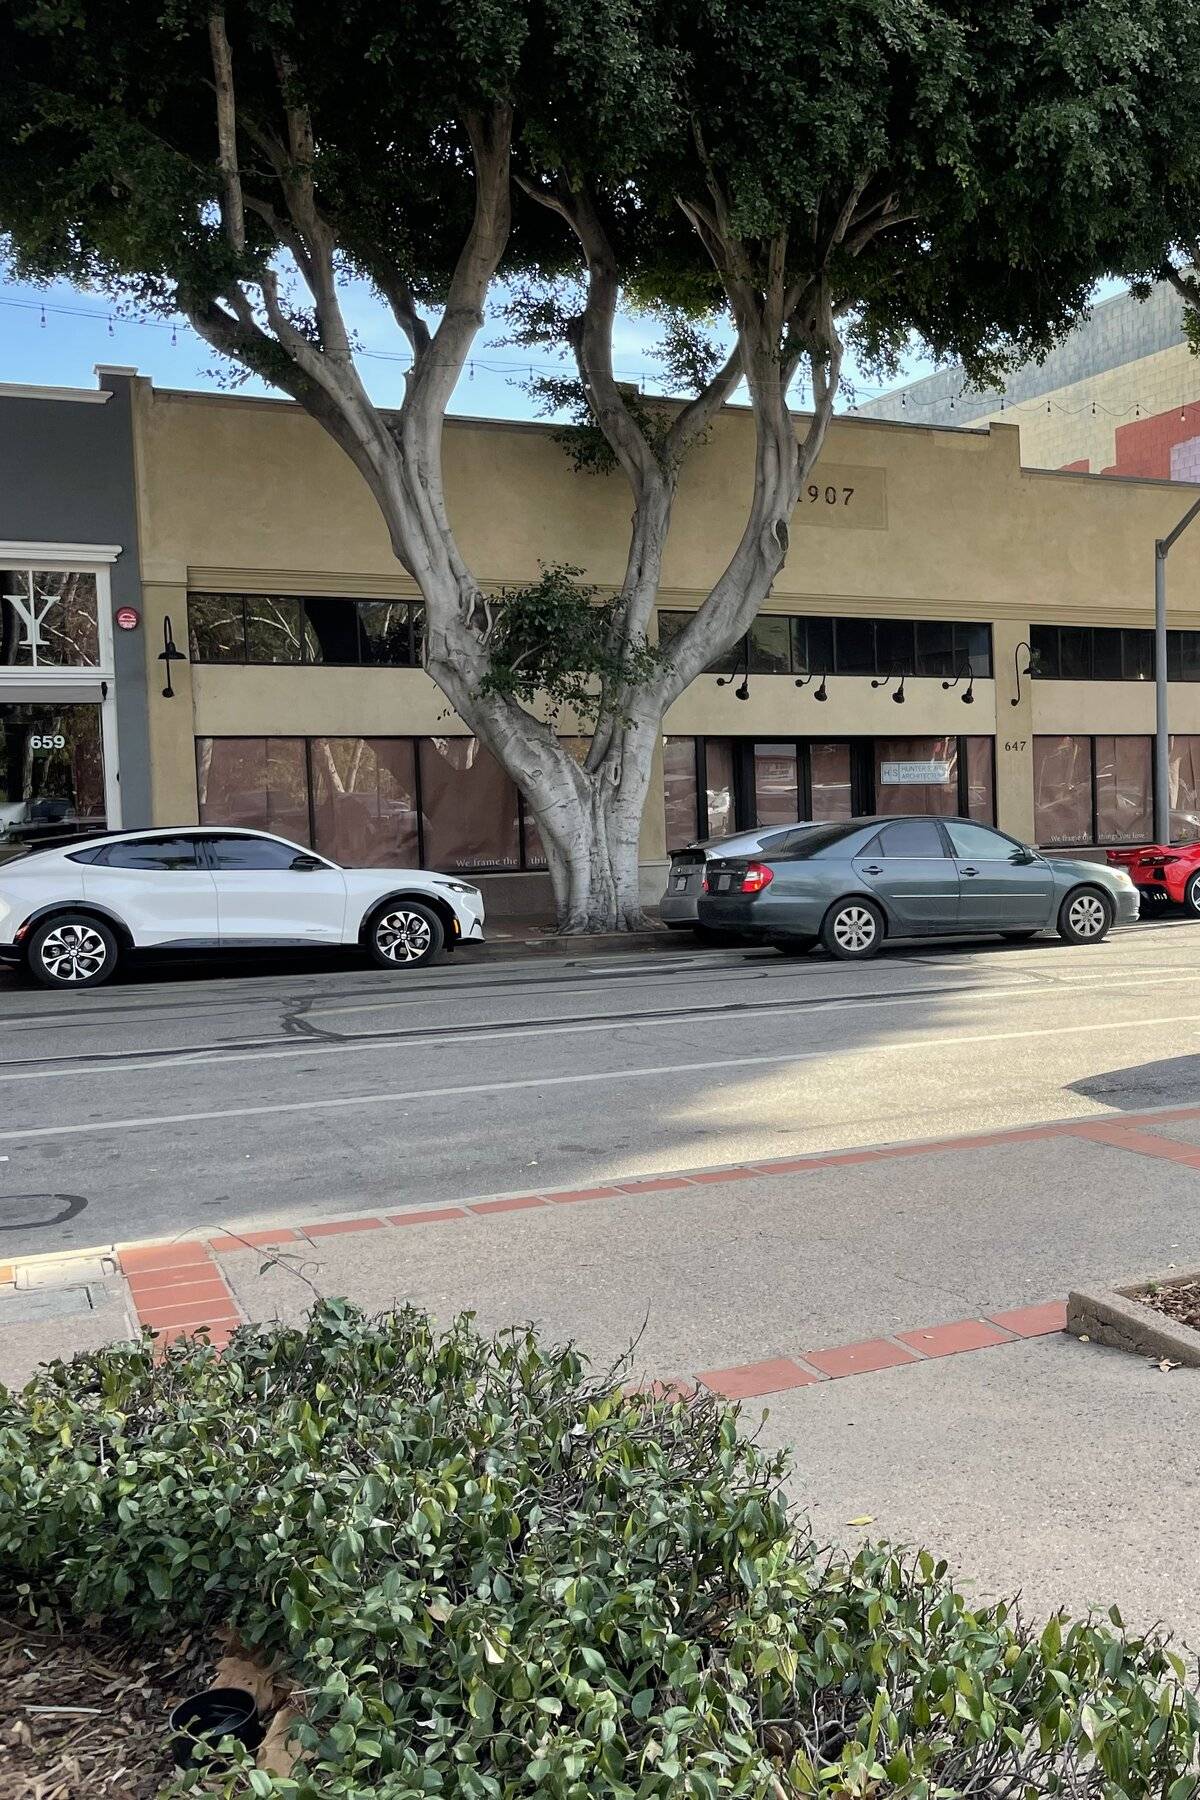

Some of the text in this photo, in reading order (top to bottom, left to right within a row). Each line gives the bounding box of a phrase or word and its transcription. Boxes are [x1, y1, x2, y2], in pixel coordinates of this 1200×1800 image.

[30, 735, 65, 749] 659
[1004, 741, 1027, 751] 647
[456, 856, 547, 868] We frame the thin
